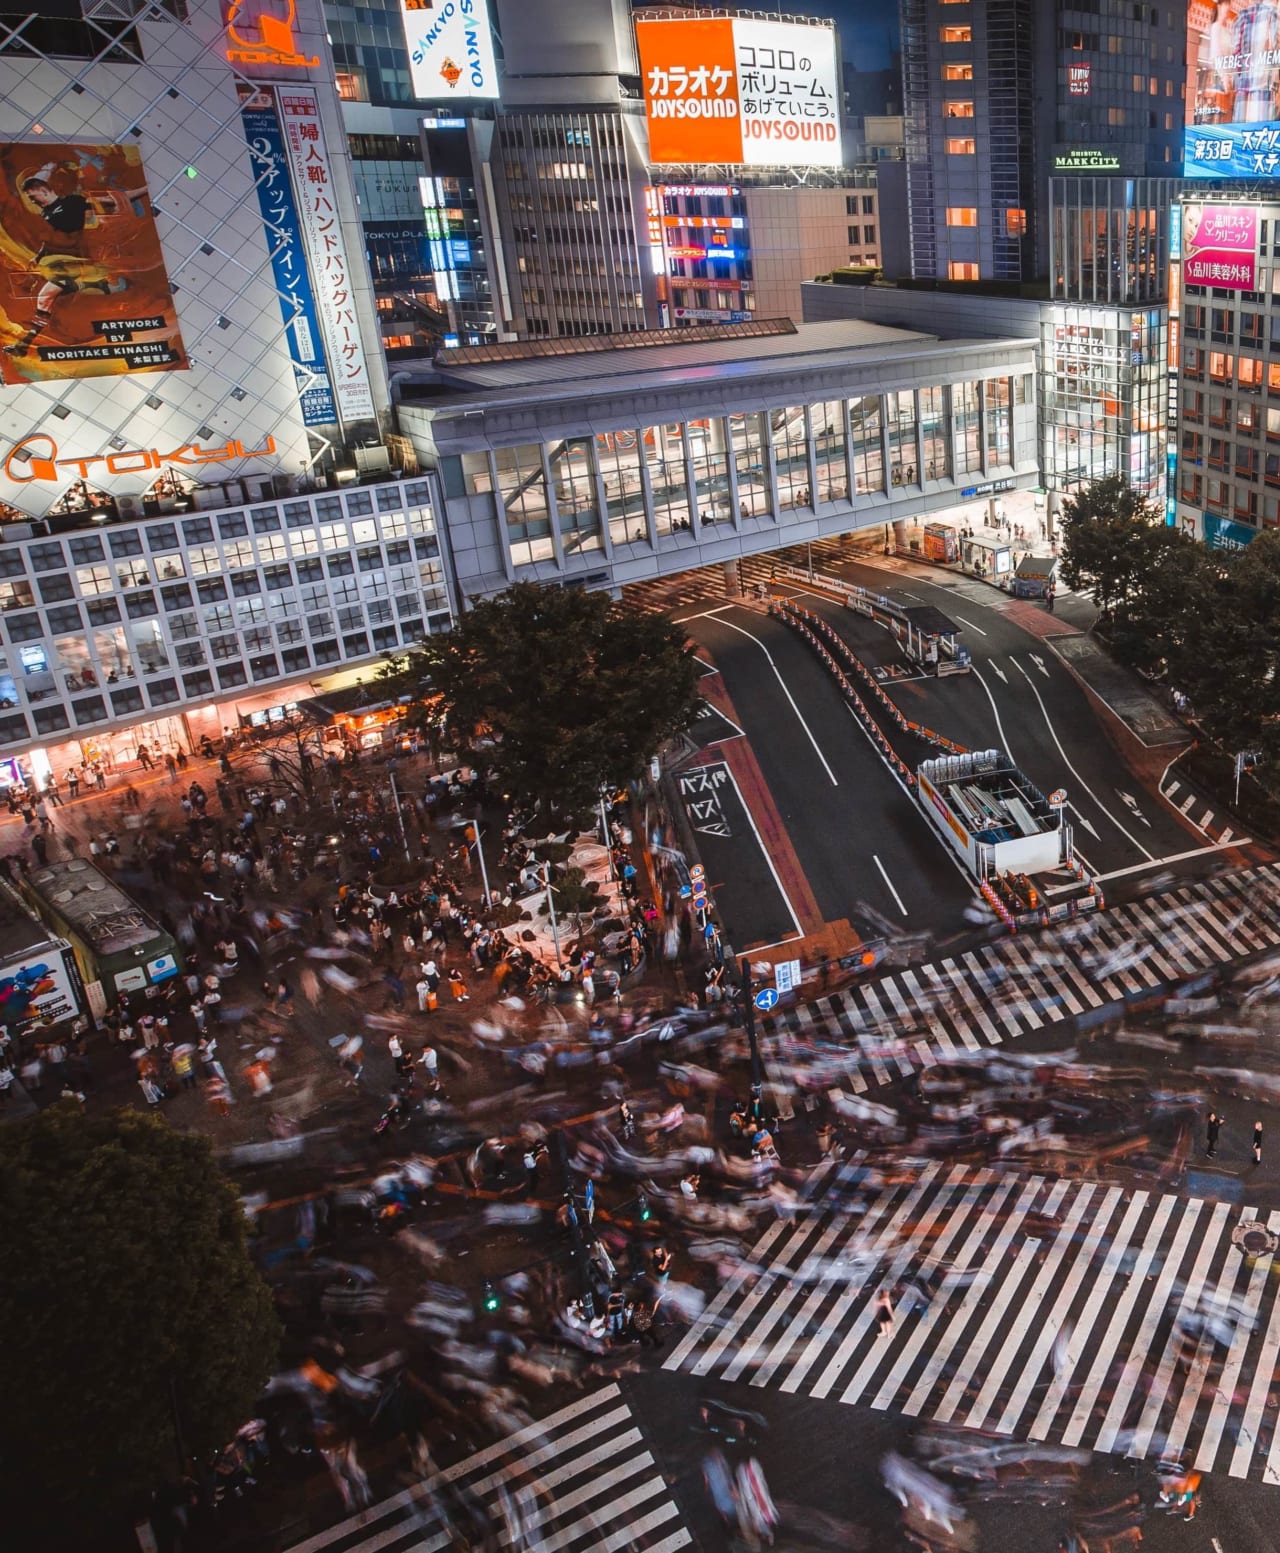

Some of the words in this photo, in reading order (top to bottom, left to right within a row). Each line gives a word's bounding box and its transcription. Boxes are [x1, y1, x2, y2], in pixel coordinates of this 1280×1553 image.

[412, 3, 454, 65] SANKYO
[739, 46, 812, 72] ココロの
[648, 66, 733, 96] カラオケ
[741, 71, 833, 99] ボリューム、
[651, 98, 738, 118] JOYSOUND
[743, 98, 836, 119] あげていこう。
[744, 119, 837, 141] JOYSOUND
[1194, 140, 1233, 160] 第53回
[1056, 157, 1088, 165] MARK
[1090, 157, 1118, 165] CITY
[365, 231, 399, 240] TOKYU
[1214, 229, 1249, 243] クリニック
[300, 122, 362, 378] 婦人靴・ハンドバッグバーゲン
[1193, 263, 1251, 283] 品川美容外科
[101, 319, 160, 331] ARTWORK
[110, 335, 126, 343] BY
[47, 348, 110, 360] NORITAKE
[114, 344, 163, 355] KINASHI
[57, 434, 277, 478] TOKYU
